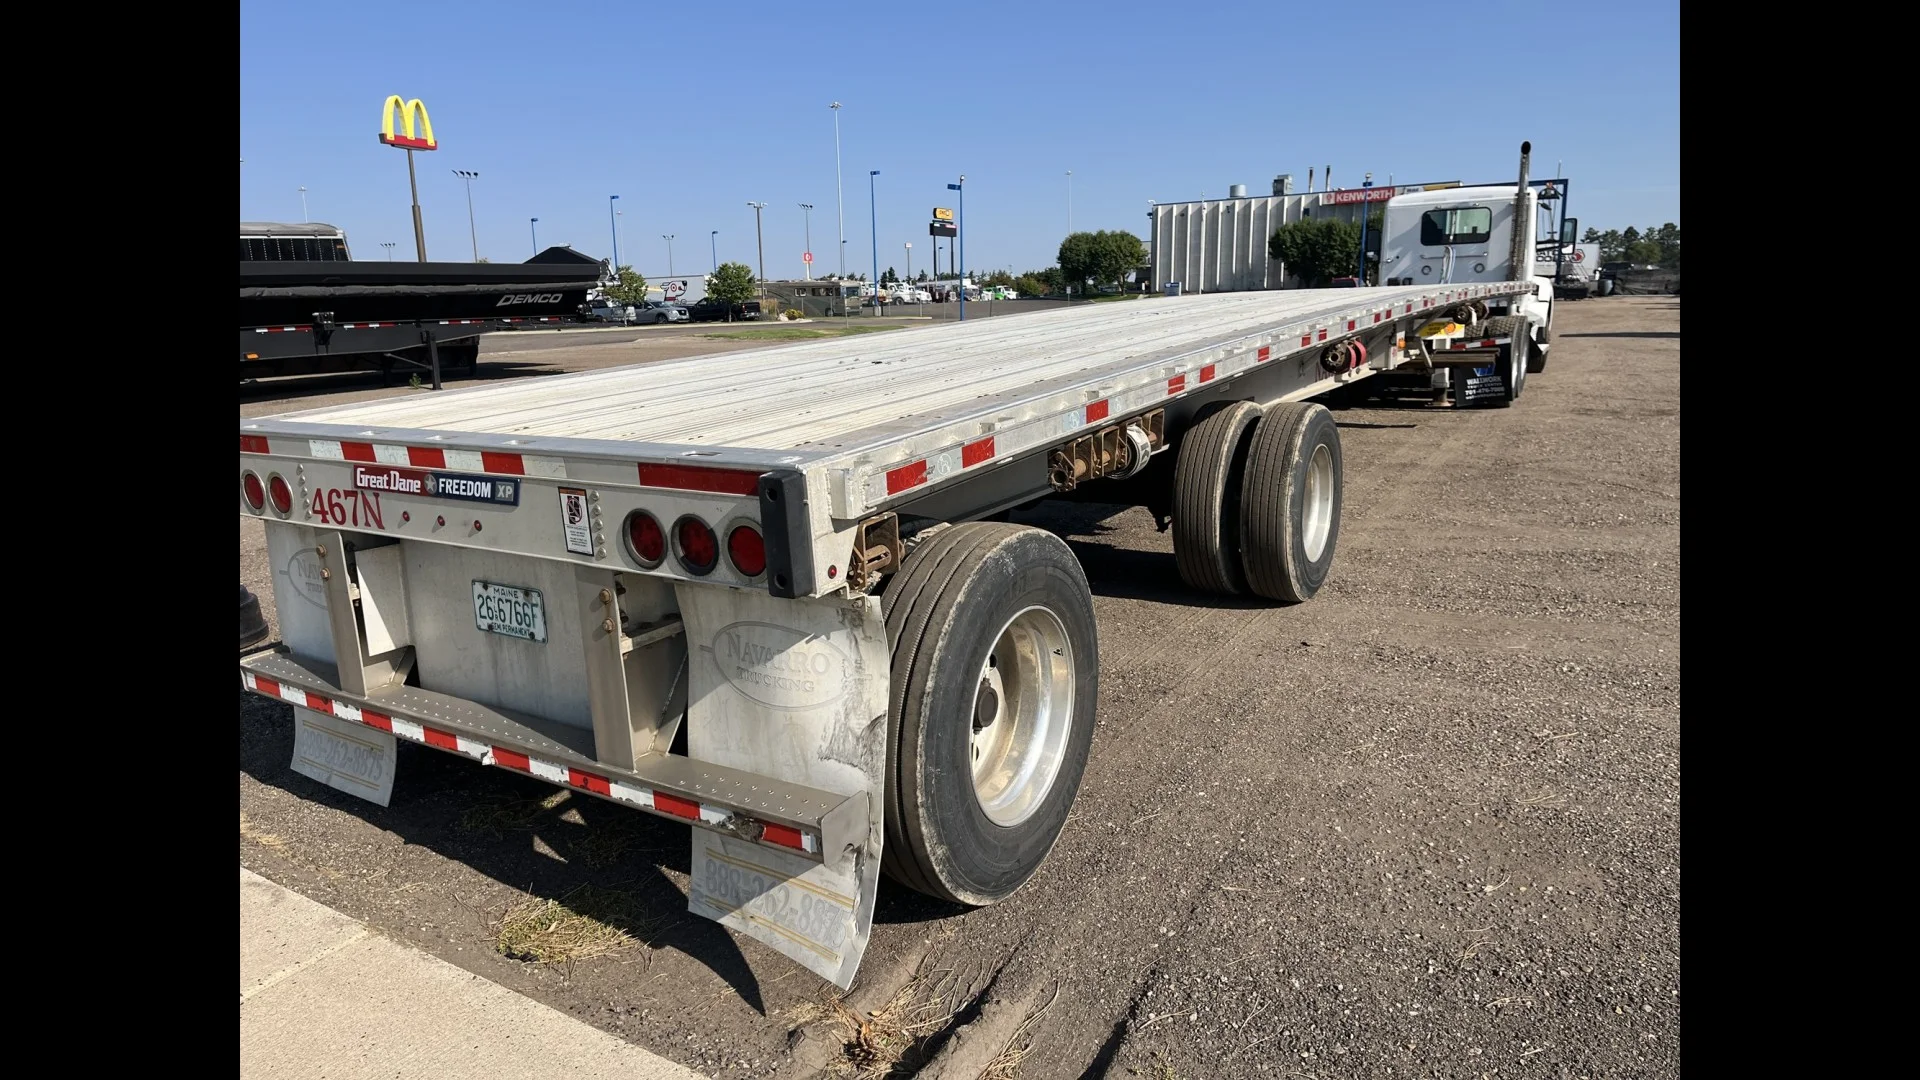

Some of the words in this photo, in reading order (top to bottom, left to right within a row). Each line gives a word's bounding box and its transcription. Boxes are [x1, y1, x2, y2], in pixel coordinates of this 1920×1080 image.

[1336, 188, 1393, 202] KENWORTH
[496, 293, 563, 307] DEMCO
[356, 467, 389, 489] Great
[389, 470, 421, 493] Dane
[438, 477, 492, 499] FREEDOM
[497, 484, 514, 499] XP
[311, 487, 386, 530] 467N
[493, 587, 519, 599] MAINE
[502, 624, 530, 637] PERMANENT
[727, 630, 831, 676] NAVARRO
[736, 664, 815, 693] TRUCKING
